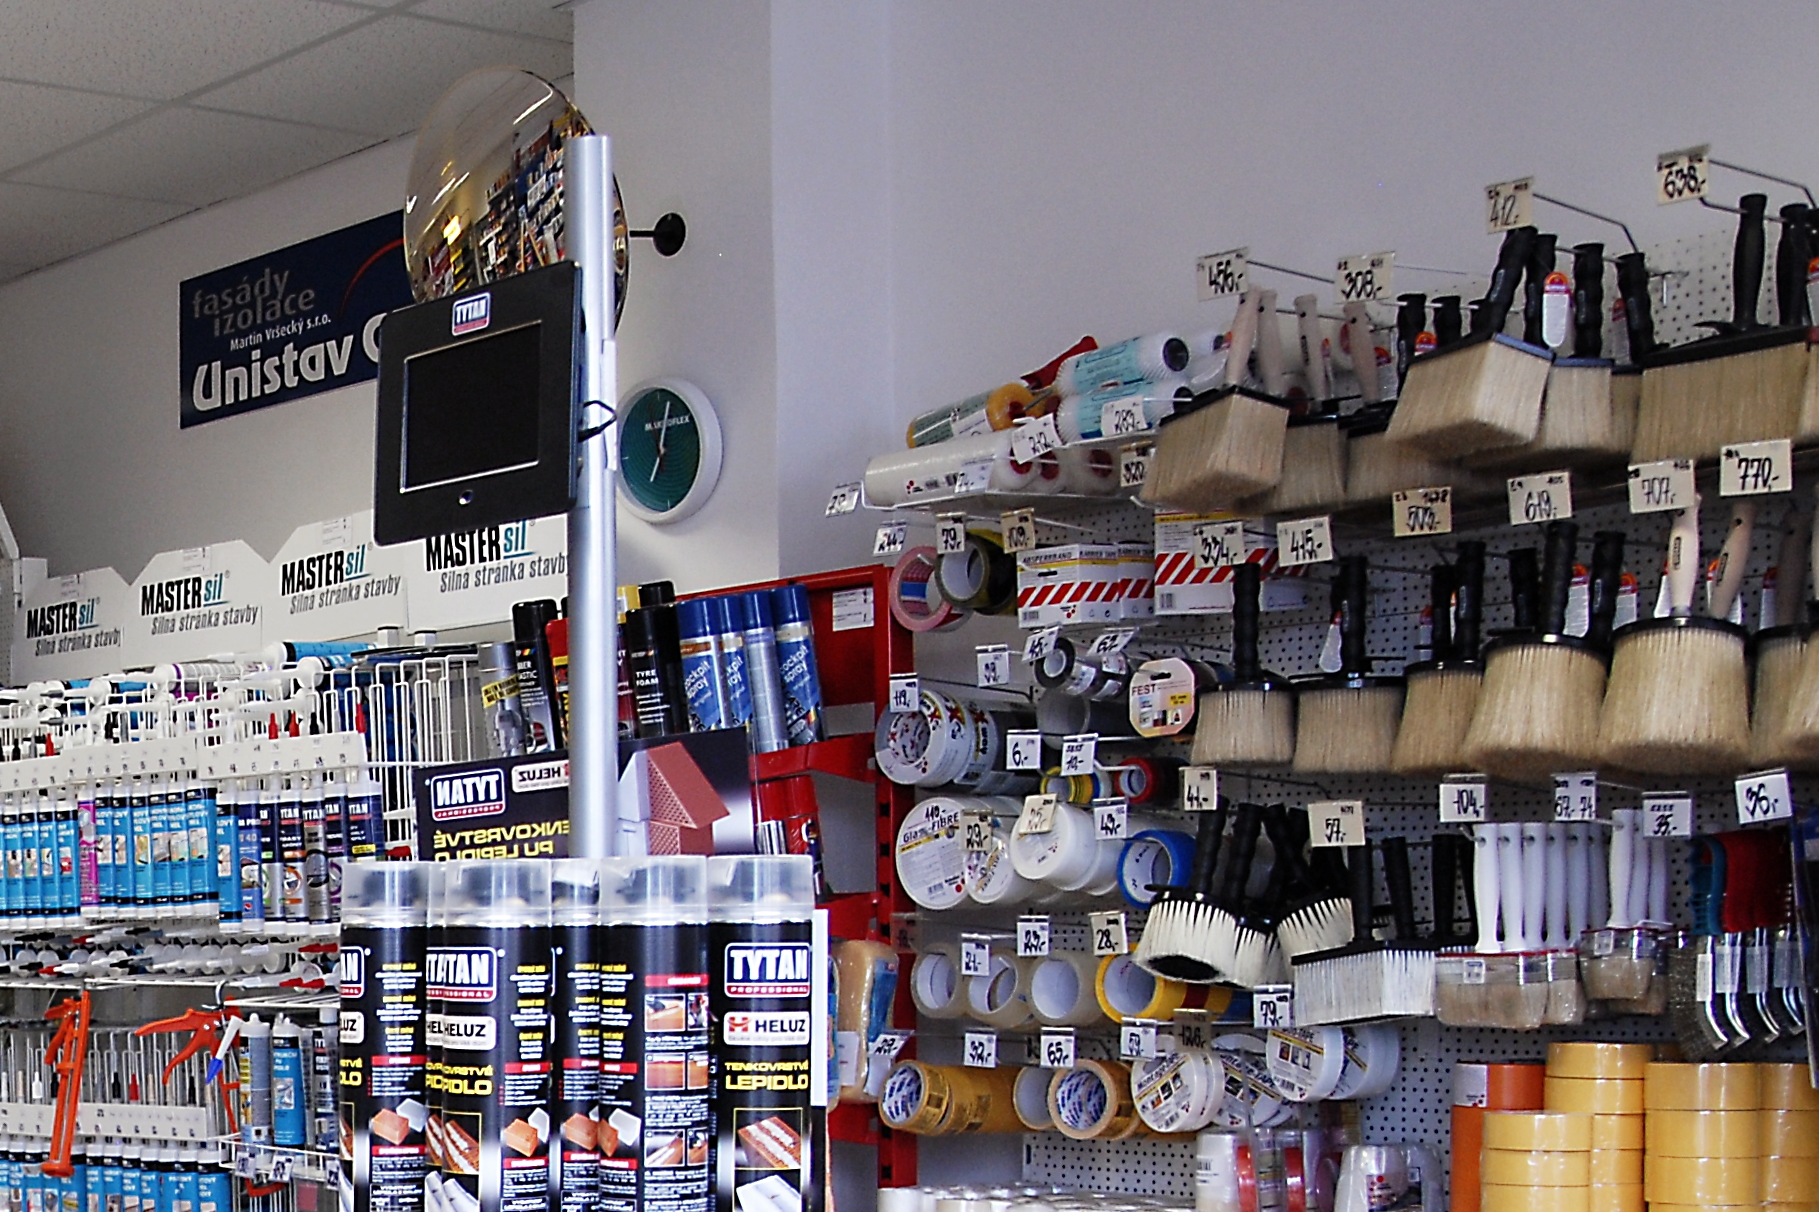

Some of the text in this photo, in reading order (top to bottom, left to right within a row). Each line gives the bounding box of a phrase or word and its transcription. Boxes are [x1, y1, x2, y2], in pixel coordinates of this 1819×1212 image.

[192, 268, 289, 318] fasády
[213, 289, 315, 337] izolace
[455, 298, 485, 323] TYTAN
[230, 314, 331, 351] Martin Vršecký s.r.o.
[193, 334, 353, 412] Unistav
[1738, 457, 1779, 492] 770,-
[440, 569, 469, 592] Silná
[475, 560, 524, 584] stránka
[290, 574, 401, 614] Silná stránka stavby
[151, 605, 259, 635] Silná stránka stavby
[58, 633, 91, 653] stránka
[635, 669, 656, 679] TYRE
[1132, 684, 1156, 695] FEST
[1097, 929, 1118, 951] 28,-
[730, 949, 808, 981] TYTAN
[755, 1019, 806, 1033] HELUZ
[725, 1074, 809, 1090] LEPIDLO
